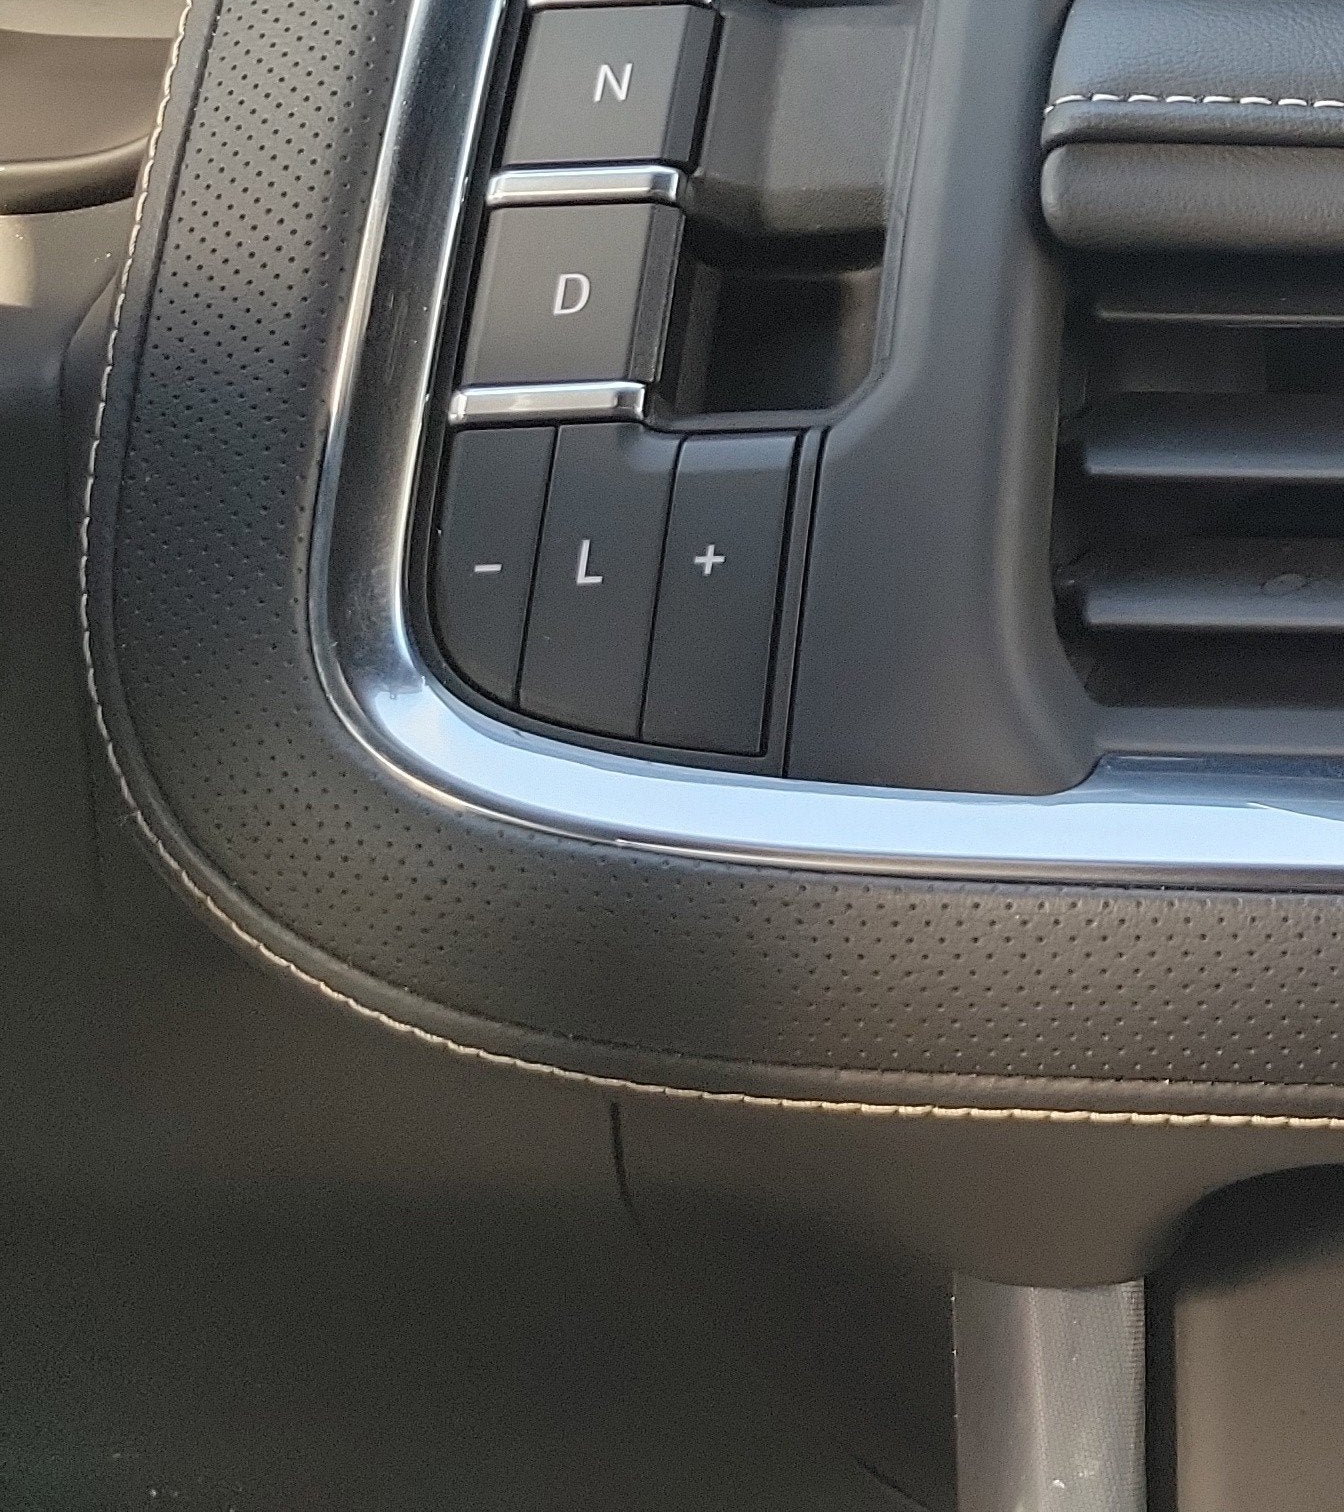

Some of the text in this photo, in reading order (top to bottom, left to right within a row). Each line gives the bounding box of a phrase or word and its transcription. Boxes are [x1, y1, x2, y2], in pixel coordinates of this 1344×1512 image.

[593, 62, 633, 103] N
[552, 272, 591, 316] D
[575, 538, 604, 586] L
